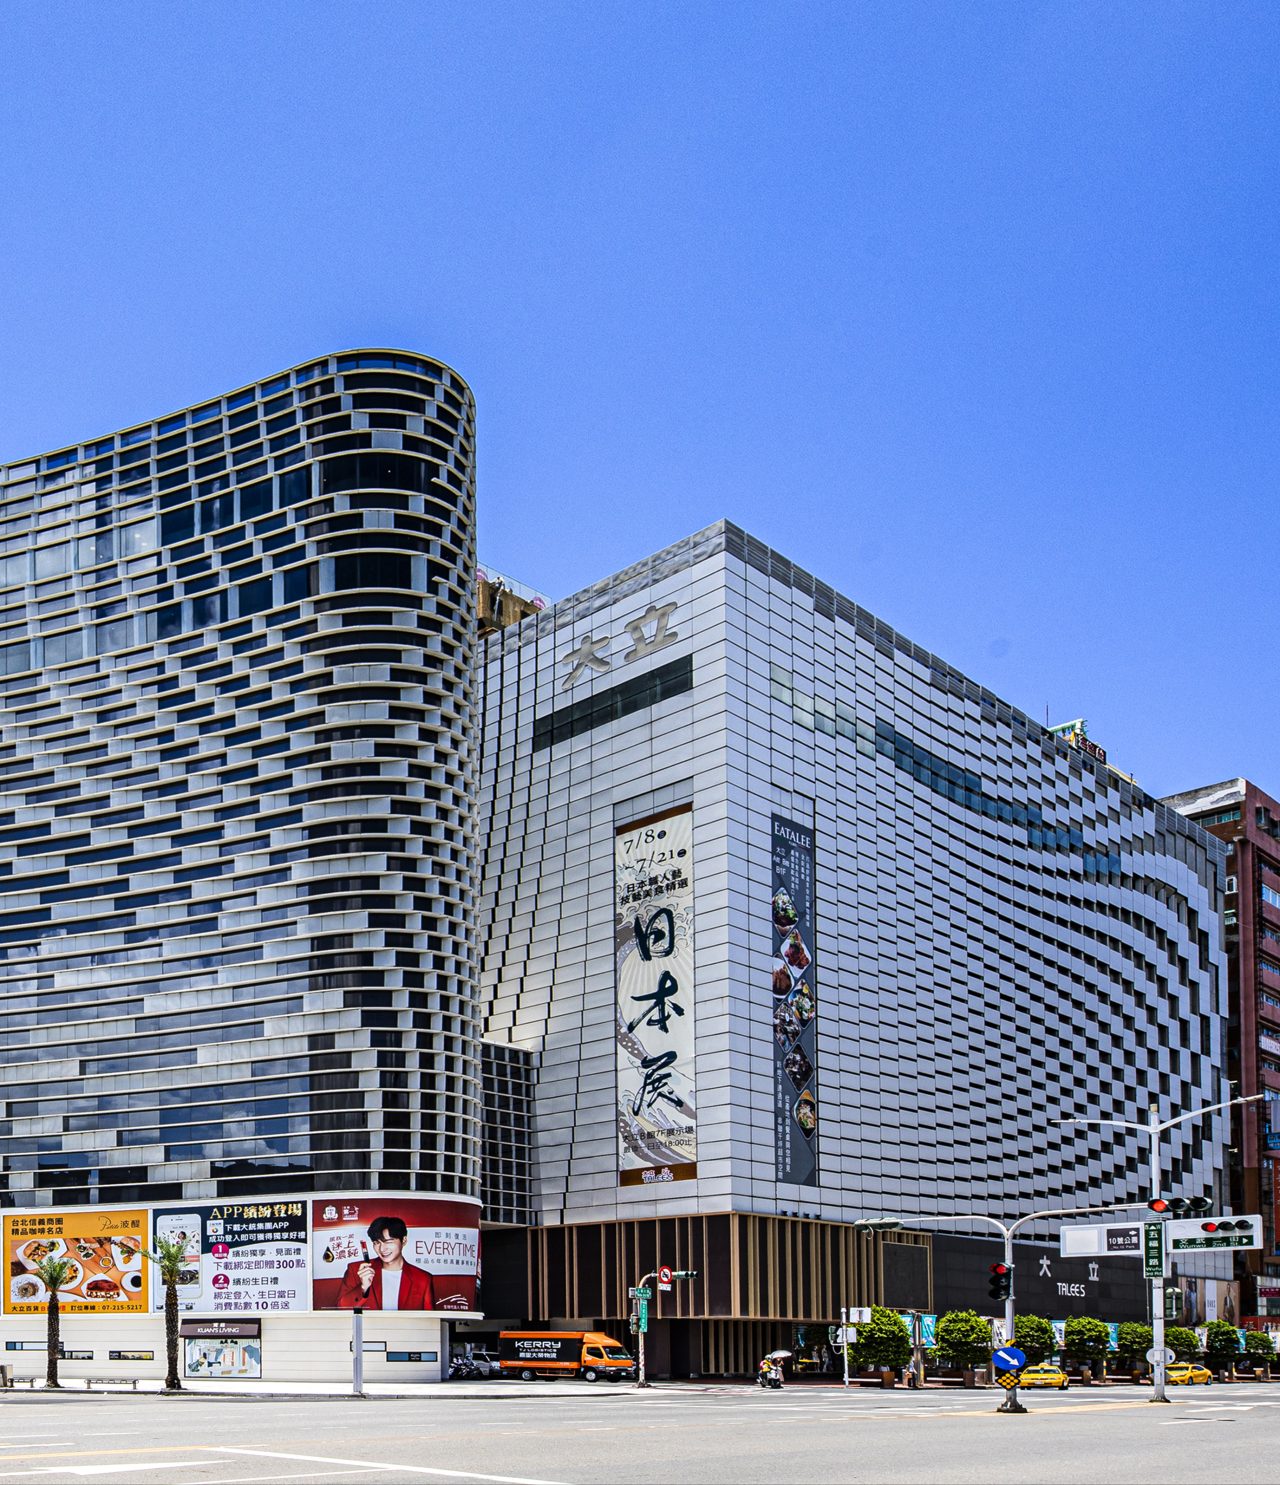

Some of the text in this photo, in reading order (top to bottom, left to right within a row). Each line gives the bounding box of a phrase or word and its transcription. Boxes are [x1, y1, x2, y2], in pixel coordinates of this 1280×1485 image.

[561, 601, 679, 690] 大立
[623, 829, 655, 854] 7/8
[774, 821, 811, 848] EATALEE
[627, 908, 685, 1116] 日本展
[209, 1203, 303, 1219] APP繽紛登場
[11, 1218, 64, 1227] 台北信義商圈
[225, 1221, 290, 1232] 下載大統集團APP
[11, 1227, 64, 1236] 精品咖啡名店
[208, 1231, 306, 1243] 成功登入即可獲得獨享好禮
[415, 1241, 476, 1258] EVERYTIME
[1039, 1255, 1100, 1282] 大立
[232, 1277, 279, 1286] 繽紛生日禮
[1056, 1282, 1086, 1297] TALEES
[514, 1341, 562, 1349] KERRY
